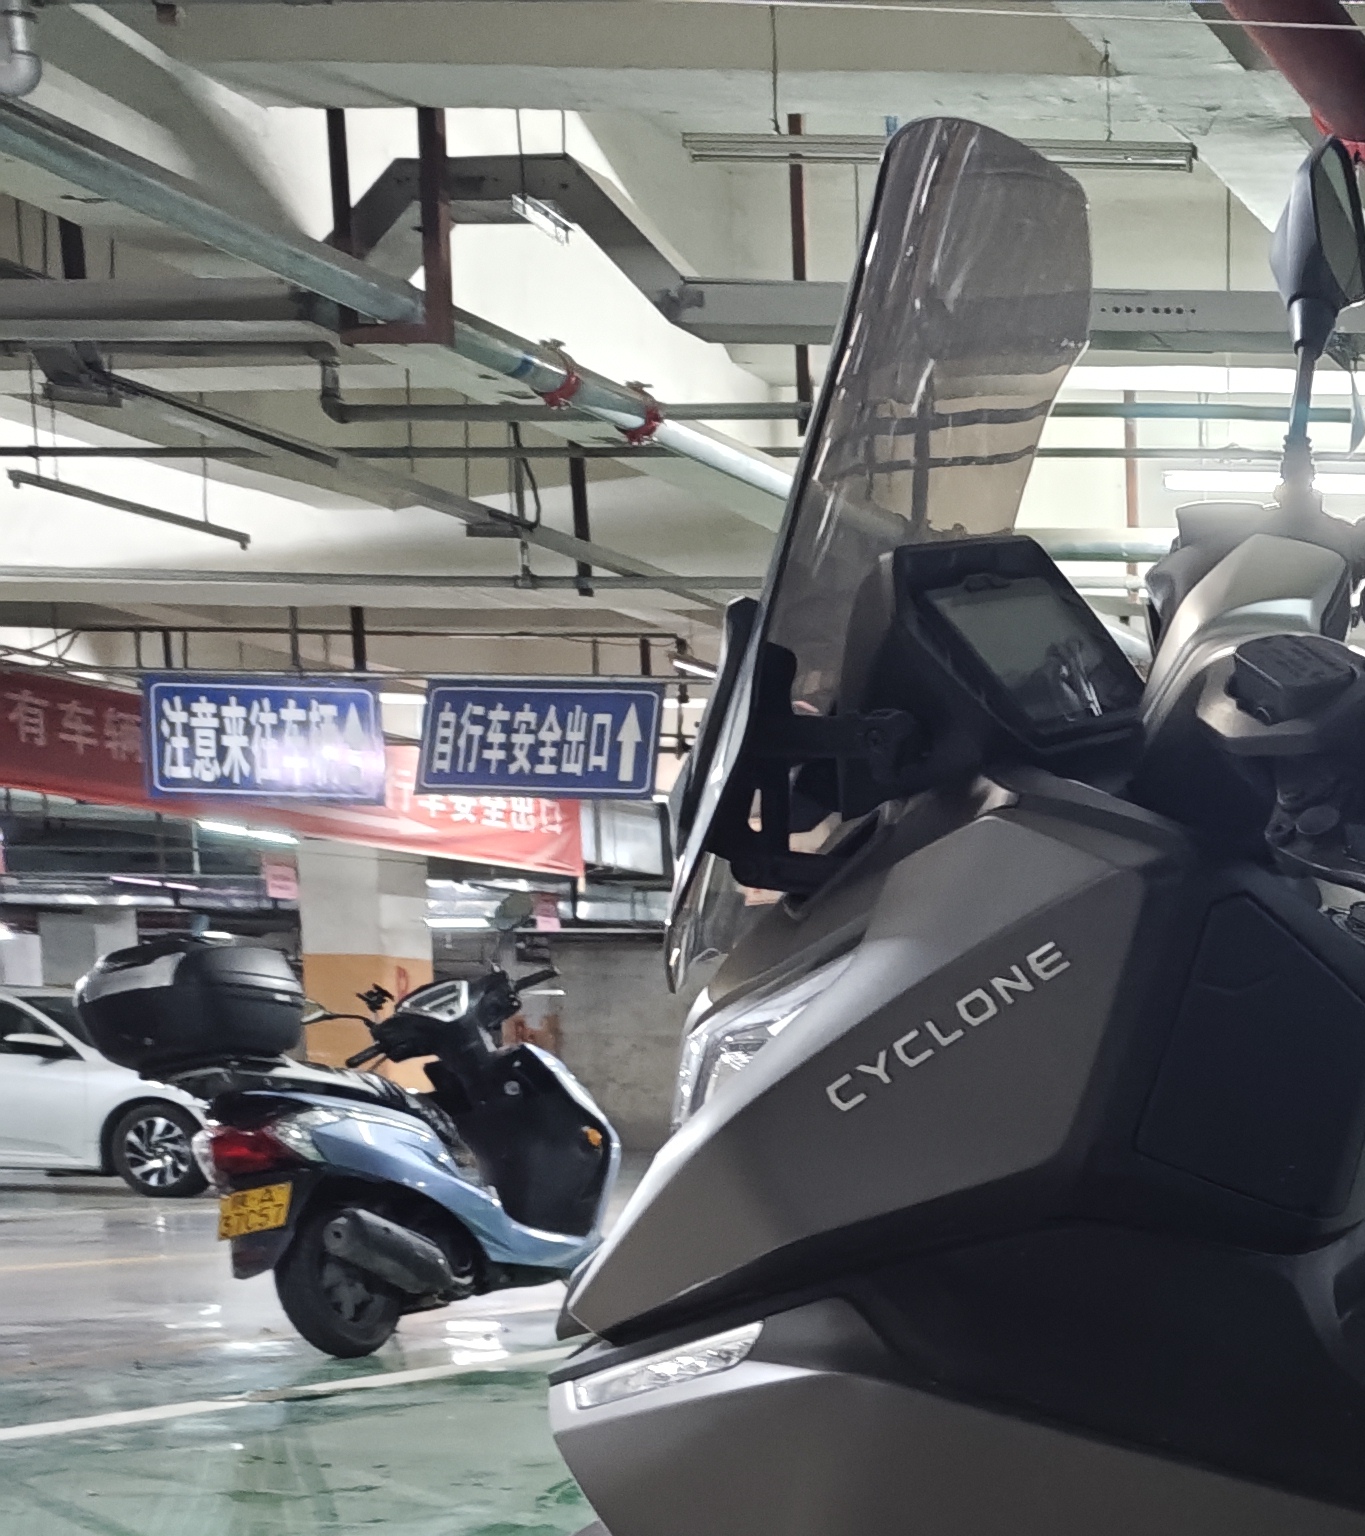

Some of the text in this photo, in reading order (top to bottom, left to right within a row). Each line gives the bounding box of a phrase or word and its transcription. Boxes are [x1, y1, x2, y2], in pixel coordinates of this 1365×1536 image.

[431, 702, 613, 777] 自行车安全出口
[826, 941, 1072, 1112] CYCLONE
